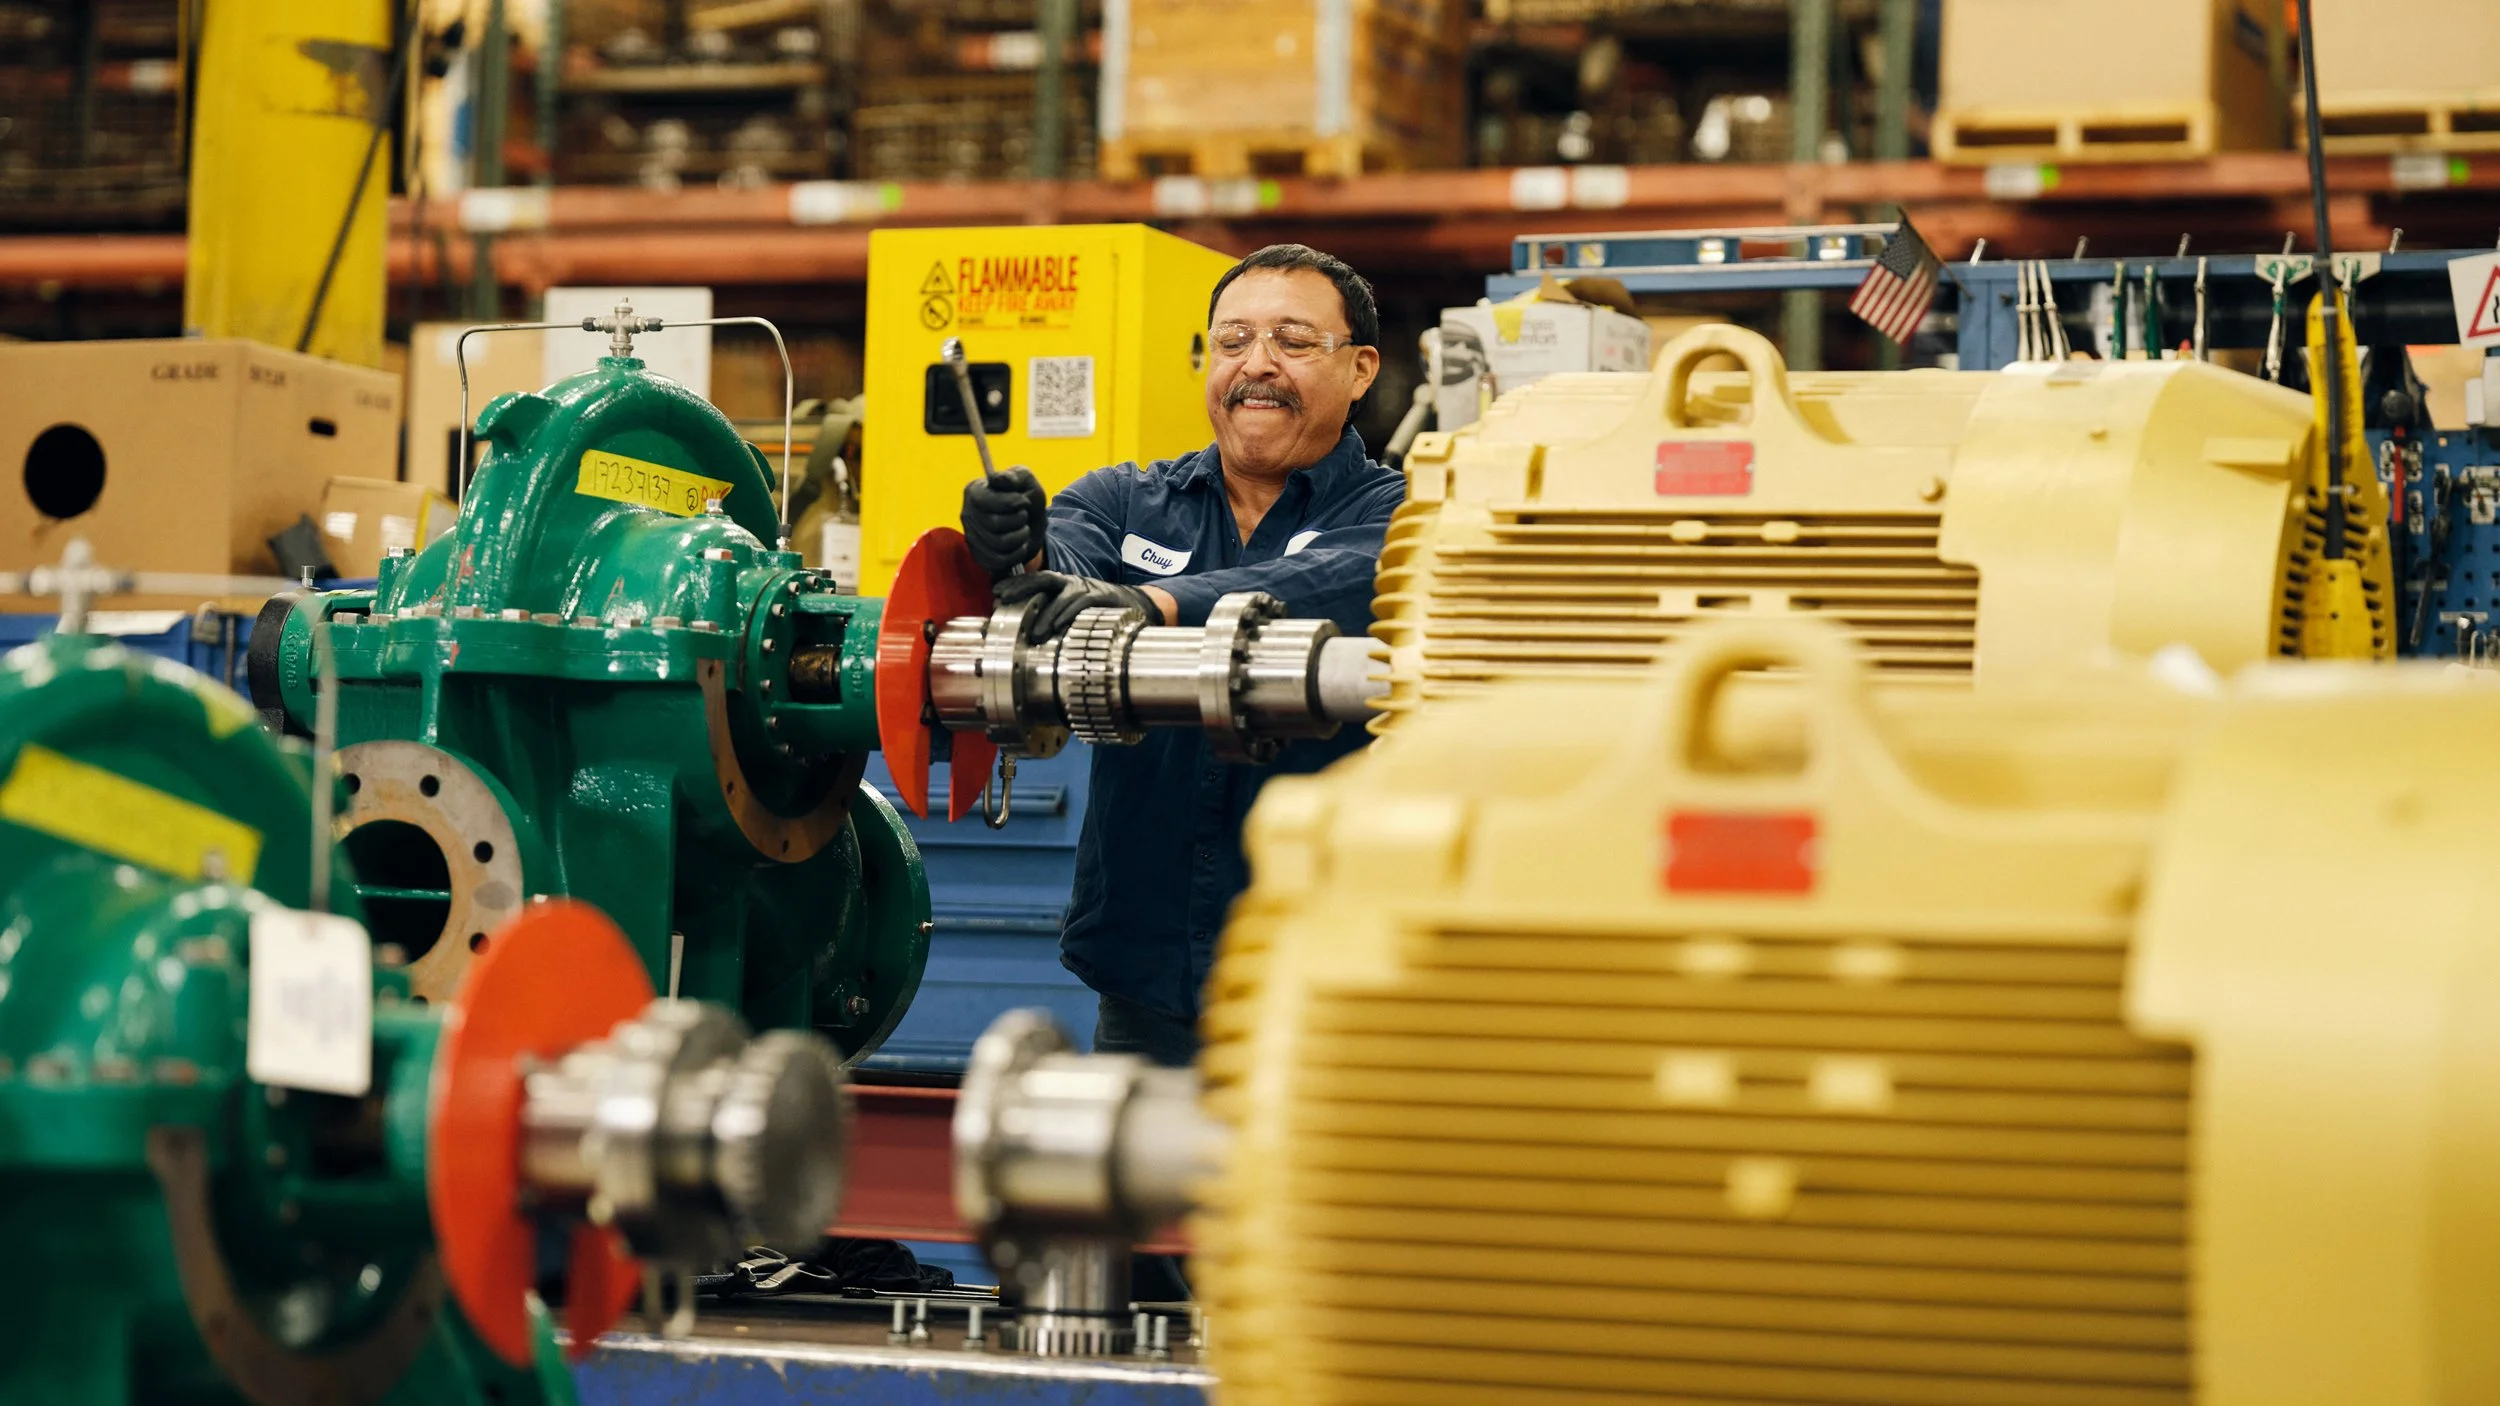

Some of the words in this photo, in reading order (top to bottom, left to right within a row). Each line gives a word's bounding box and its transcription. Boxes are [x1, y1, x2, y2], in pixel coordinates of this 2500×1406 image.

[959, 255, 1078, 294] FLAMMABLE
[959, 294, 994, 312] KEEP
[998, 294, 1028, 312] FIRE
[1033, 294, 1075, 312] AWAY
[593, 459, 671, 506] 17237137
[1141, 548, 1173, 569] Chuy
